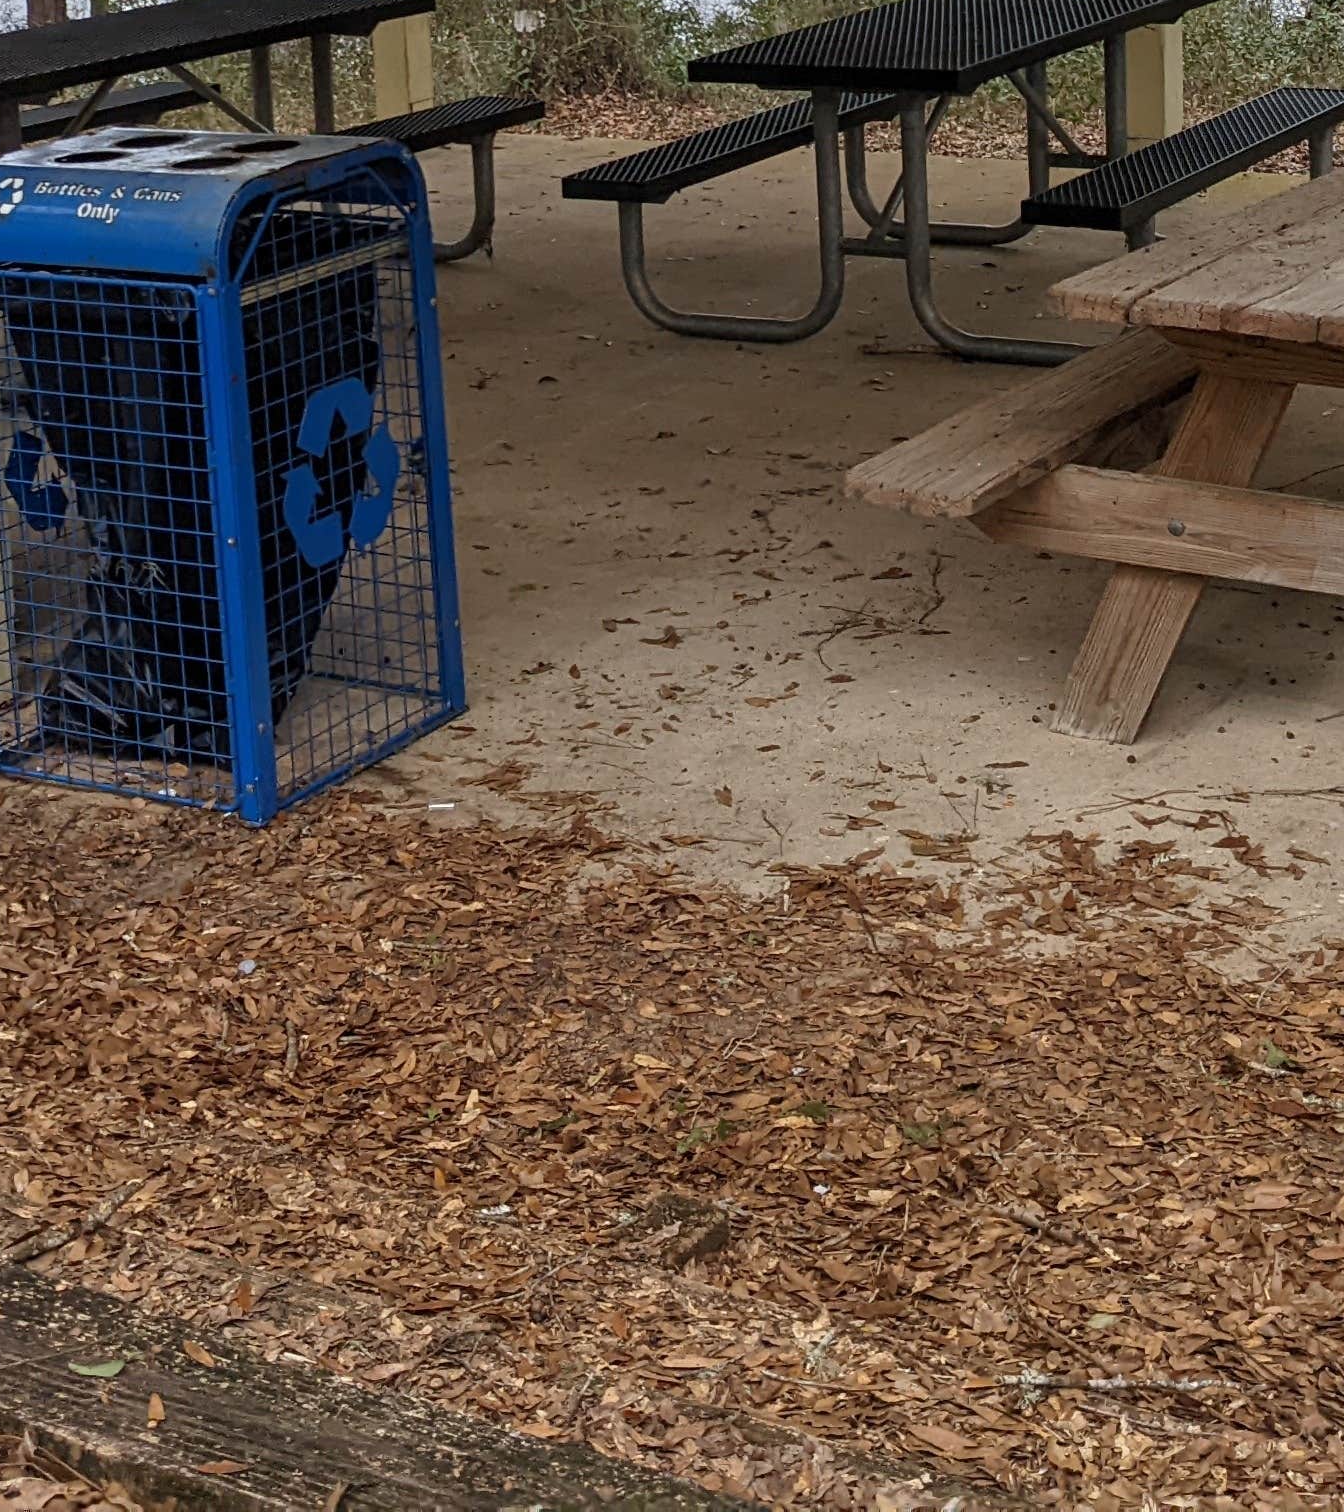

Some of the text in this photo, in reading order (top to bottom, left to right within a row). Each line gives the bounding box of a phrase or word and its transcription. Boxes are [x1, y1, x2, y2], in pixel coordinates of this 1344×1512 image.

[33, 181, 184, 202] Bottles & Cans
[76, 202, 120, 224] Only
